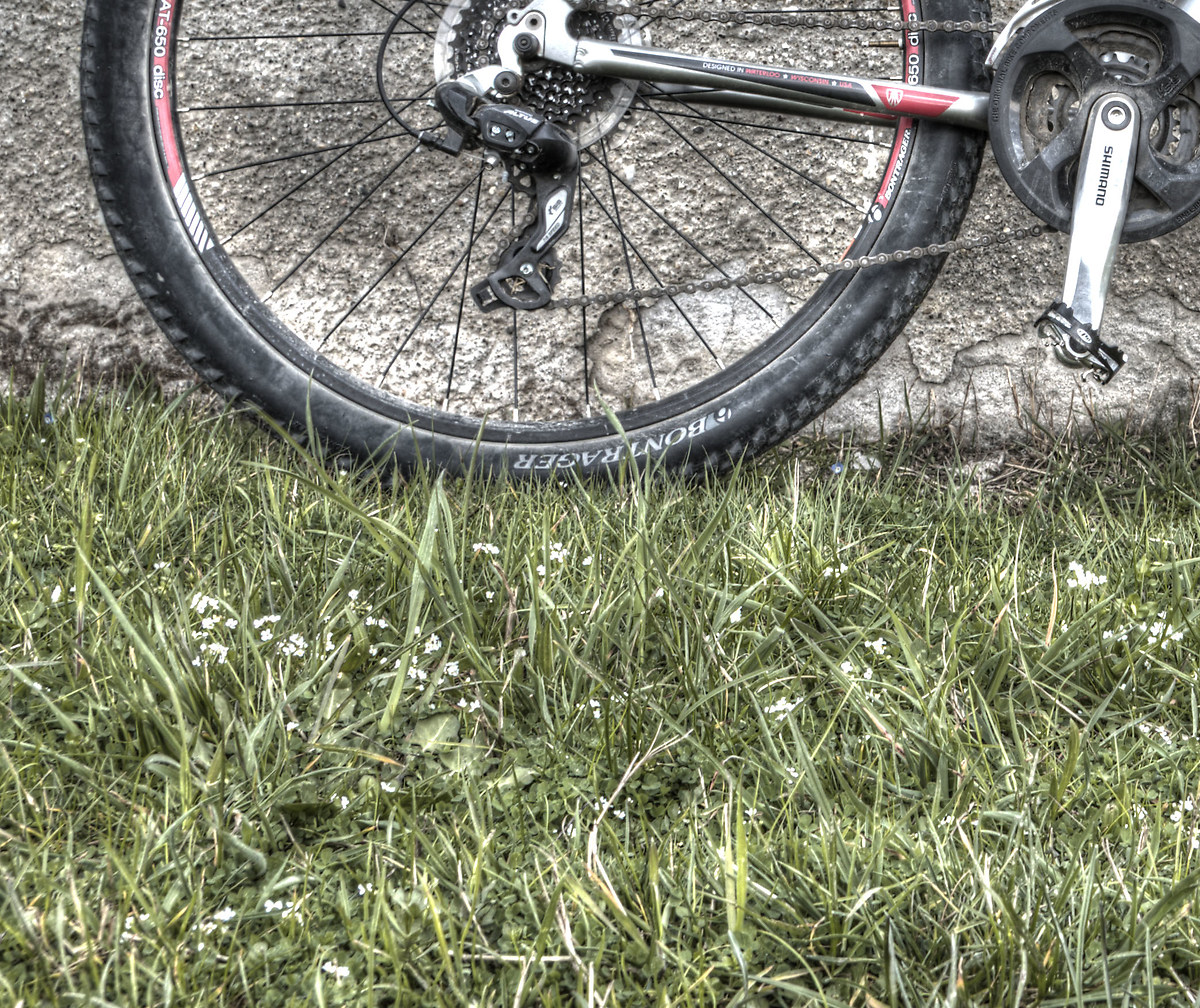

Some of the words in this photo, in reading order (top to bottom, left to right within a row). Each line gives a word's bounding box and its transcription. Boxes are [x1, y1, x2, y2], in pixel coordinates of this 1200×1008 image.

[907, 12, 920, 47] dic
[152, 64, 166, 100] disc
[702, 62, 735, 72] DESIGNED
[745, 68, 781, 78] WATERLOO
[790, 74, 830, 85] WISCONSIN
[839, 81, 853, 89] USA
[907, 54, 920, 86] 650
[503, 109, 540, 125] ALTUS
[885, 128, 911, 201] BONTRAGER
[1095, 145, 1114, 206] SHIMANO
